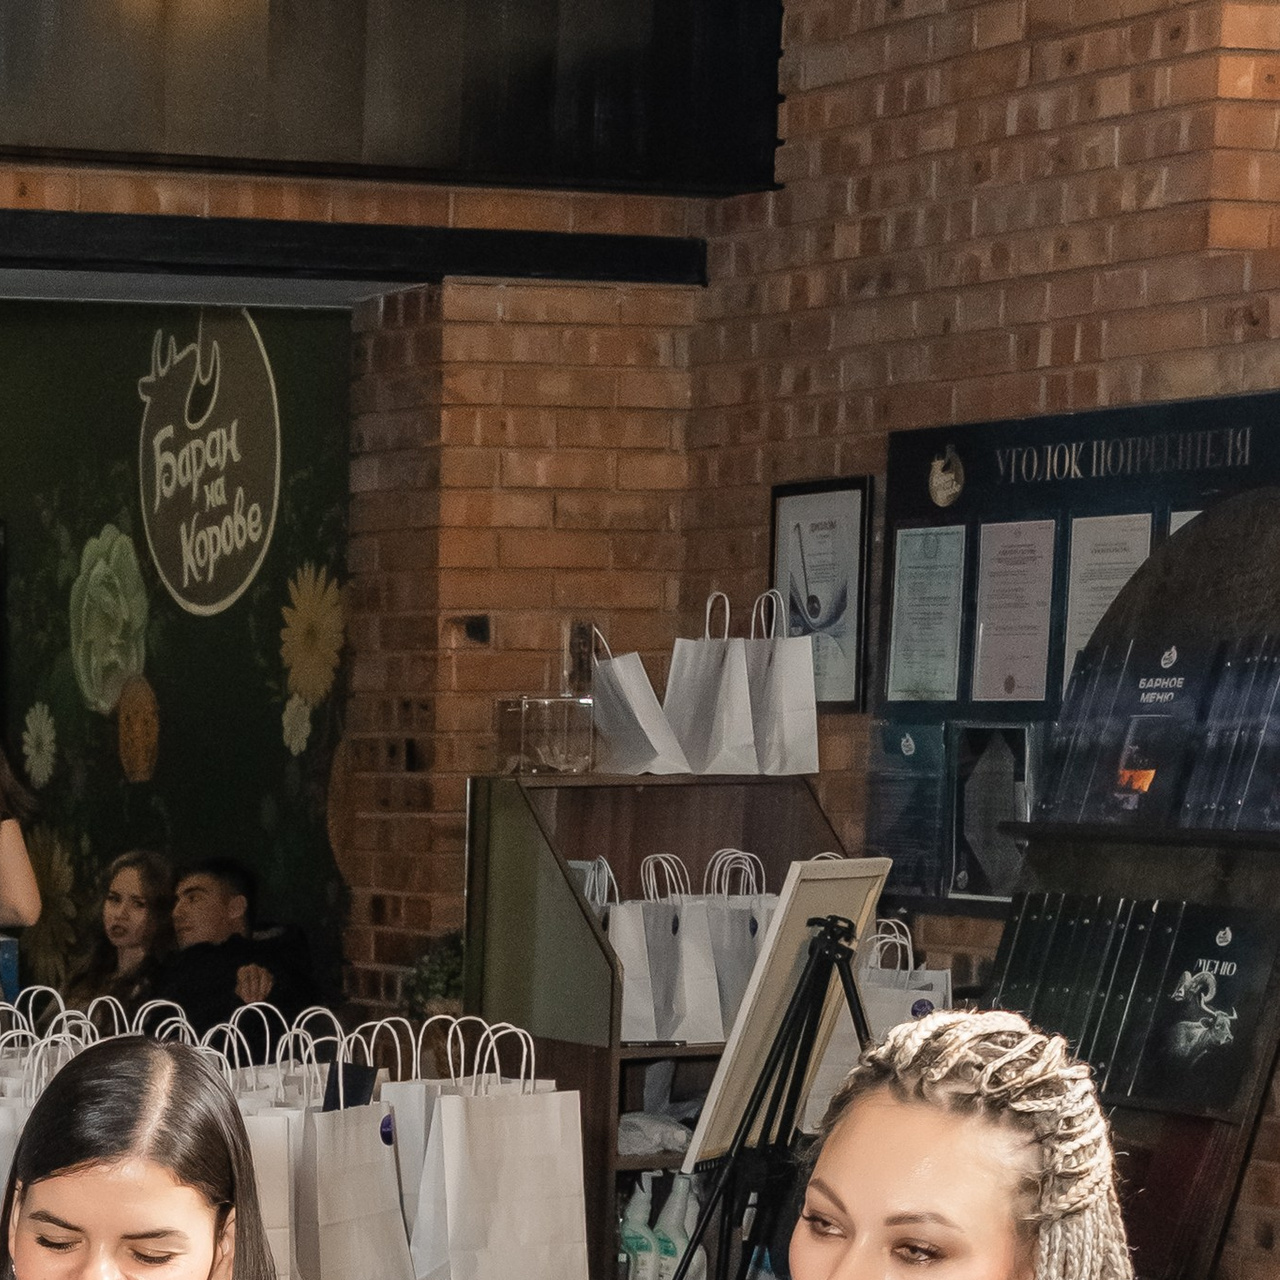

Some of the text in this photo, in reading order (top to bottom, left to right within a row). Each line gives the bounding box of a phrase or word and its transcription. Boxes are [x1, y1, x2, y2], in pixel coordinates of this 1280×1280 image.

[152, 419, 242, 514] Баран
[996, 427, 1253, 484] УГОЛОК ПОТРЕБИТЕЛЯ
[203, 476, 228, 512] на
[180, 486, 263, 588] Корове
[1138, 677, 1185, 690] БАРНОЕ
[1139, 692, 1175, 704] МЕНЮ
[1193, 958, 1237, 977] МЕНЮ
